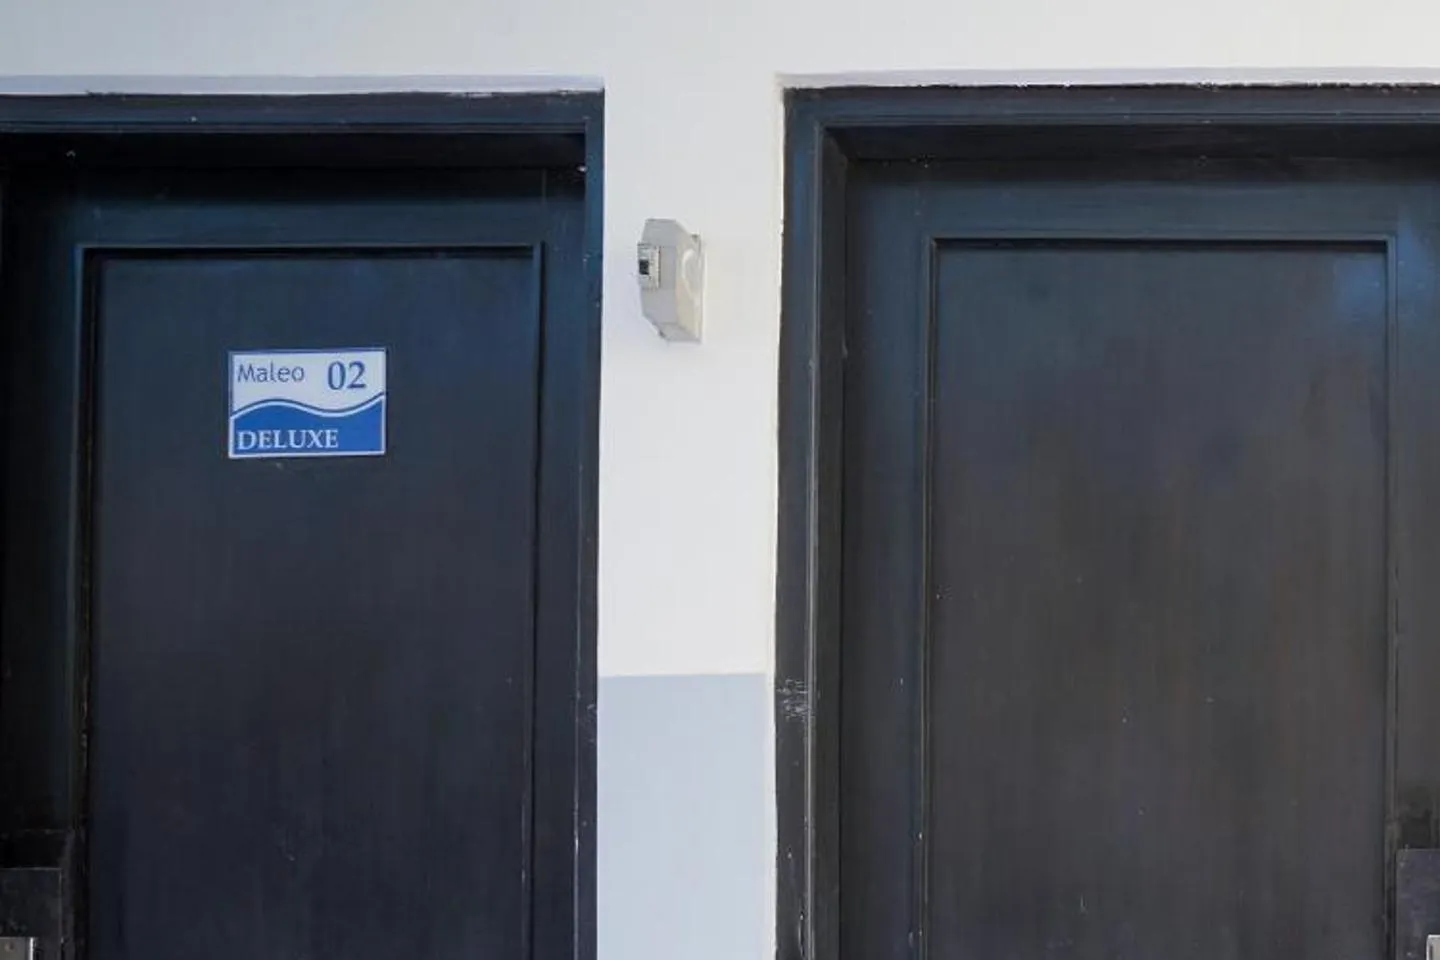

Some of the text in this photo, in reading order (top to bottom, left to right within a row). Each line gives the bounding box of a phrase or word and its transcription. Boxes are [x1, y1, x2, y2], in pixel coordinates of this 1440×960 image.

[237, 361, 367, 390] Maleo 02
[237, 429, 339, 450] DELUXE
